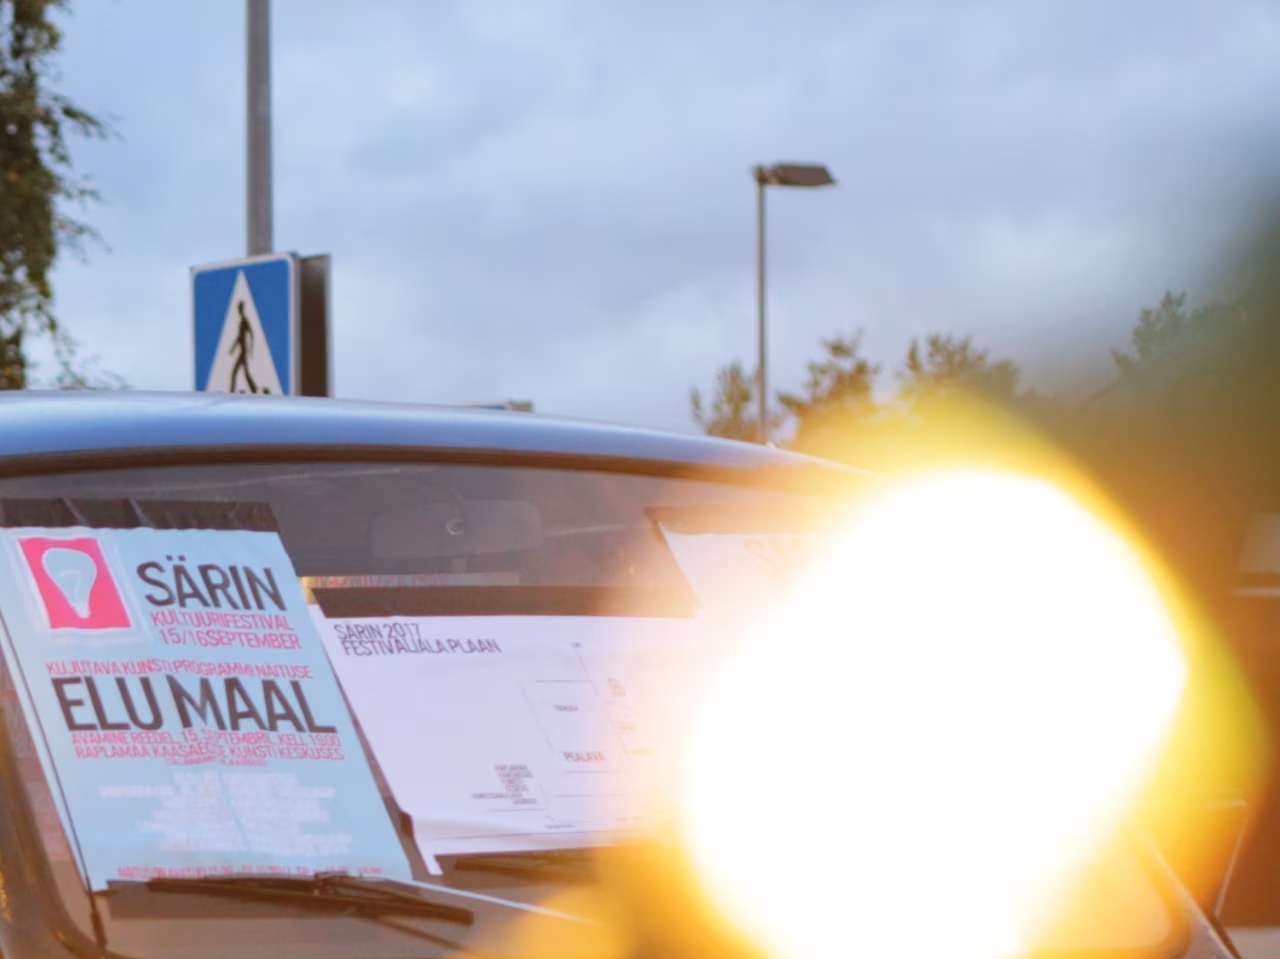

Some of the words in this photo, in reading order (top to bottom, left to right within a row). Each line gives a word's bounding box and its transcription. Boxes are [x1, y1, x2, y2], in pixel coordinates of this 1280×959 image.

[137, 554, 287, 611] SÄRIN
[151, 610, 295, 631] KULTUURIFESTIVAL
[383, 622, 421, 640] 2017
[447, 638, 503, 654] PLAAN
[121, 658, 173, 674] KUNSTI
[50, 675, 164, 732] ELU
[165, 674, 338, 734] MAAL
[277, 746, 345, 760] KESKUSES
